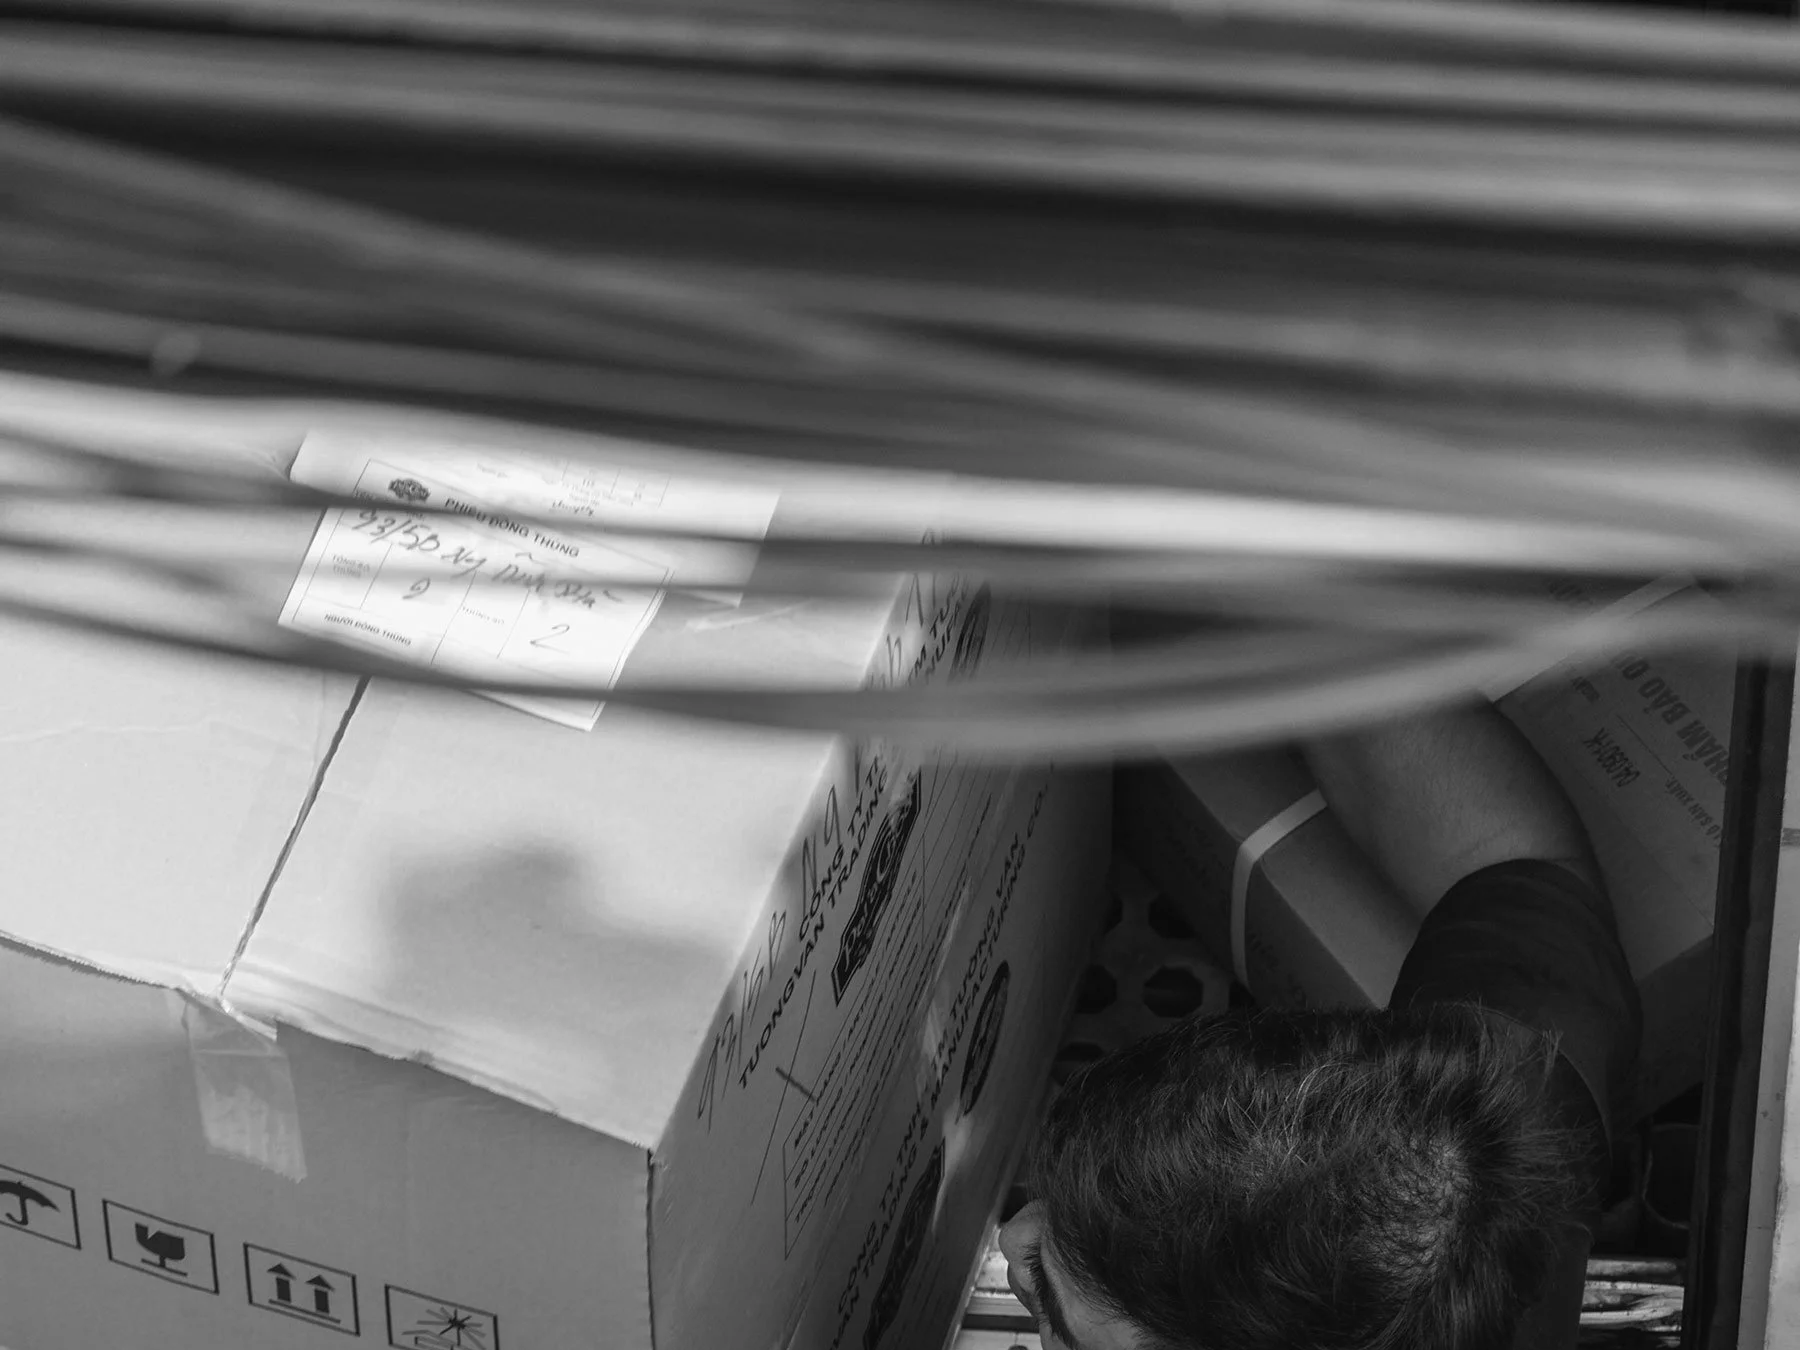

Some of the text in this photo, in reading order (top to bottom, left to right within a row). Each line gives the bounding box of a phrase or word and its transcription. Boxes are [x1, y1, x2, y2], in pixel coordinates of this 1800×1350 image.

[737, 764, 885, 1089] TUONGVAN TRADING
[861, 1140, 916, 1279] TRADING
[918, 1114, 929, 1140] &
[930, 843, 1026, 1111] MANUFACTURING
[878, 1169, 893, 1212] TY
